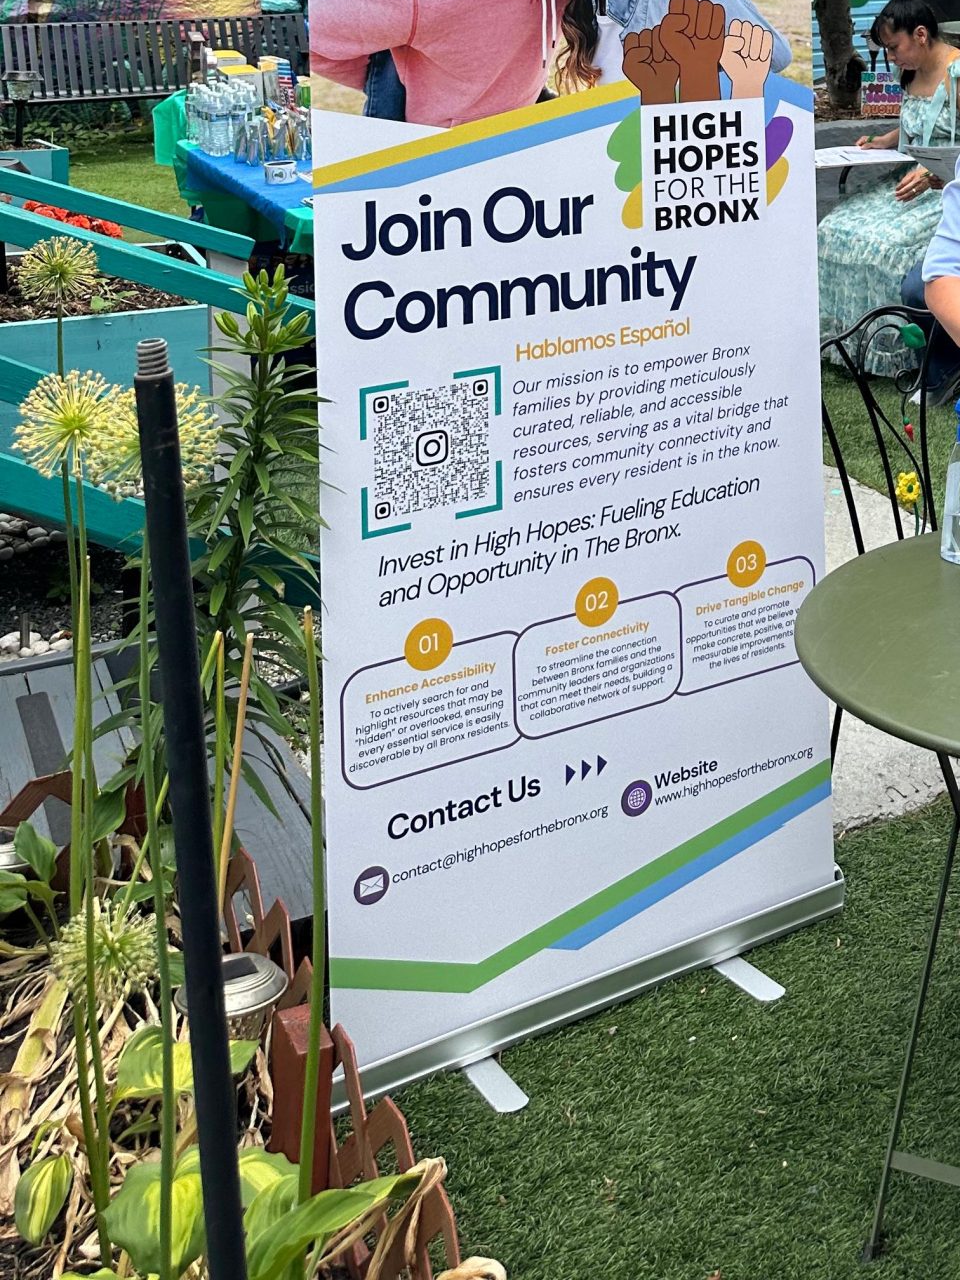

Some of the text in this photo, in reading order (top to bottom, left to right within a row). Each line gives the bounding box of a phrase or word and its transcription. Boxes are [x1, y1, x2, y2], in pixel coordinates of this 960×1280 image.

[653, 111, 743, 143] HIGH
[654, 140, 759, 175] HOPES
[655, 170, 760, 202] FOR THE
[341, 186, 594, 261] Join Our
[655, 197, 760, 232] BRONX
[343, 246, 698, 341] Community
[516, 318, 690, 361] Hablamos Español
[512, 346, 750, 395] Our mission is to empower Bronx
[515, 362, 754, 415] families by providing meticulously
[513, 384, 742, 438] curated, reliable, and accessible
[513, 396, 788, 459] resources, serving as a vital bridge that
[514, 416, 772, 480] fosters community connectivity and
[514, 438, 780, 502] ensures every resident is in the know.
[379, 477, 760, 577] Invest in High Hopes: Fueling Education
[379, 523, 680, 607] and Opportunity in The Bronx.
[735, 553, 757, 574] 03
[585, 591, 609, 612] 02
[696, 581, 804, 616] Drive Tangible Change
[703, 620, 713, 628] To
[714, 613, 740, 625] curate
[741, 608, 756, 618] and
[757, 600, 790, 616] promote
[418, 632, 439, 655] 01
[545, 622, 649, 656] Foster Connectivity
[685, 625, 736, 644] opportunities
[737, 619, 754, 630] that
[755, 616, 766, 624] we
[767, 609, 794, 622] believe
[532, 645, 662, 686] between Bronx families and the
[536, 636, 657, 674] To streamline the connection
[365, 662, 495, 704] Enhance Accessibility
[517, 652, 675, 701] community leaders and organizations
[520, 700, 538, 712] that
[540, 696, 557, 707] can
[559, 688, 581, 701] meet
[583, 683, 602, 694] their
[632, 666, 665, 680] building
[355, 688, 503, 735] highlight resources that may be
[370, 679, 489, 719] To actively search for and
[397, 726, 407, 735] or
[464, 700, 504, 716] ensuring
[529, 699, 585, 720] collaborative
[587, 689, 620, 704] network
[621, 684, 630, 694] of
[349, 749, 410, 772] discoverable
[412, 745, 424, 755] by
[426, 739, 437, 750] all
[439, 734, 465, 746] Bronx
[358, 712, 501, 758] every essential service is easily
[654, 760, 717, 789] Website
[655, 747, 813, 806] www.highhopesforthebronx.org
[387, 776, 541, 839] Contact Us
[392, 806, 608, 884] contact@highhopesforthebronx.org
